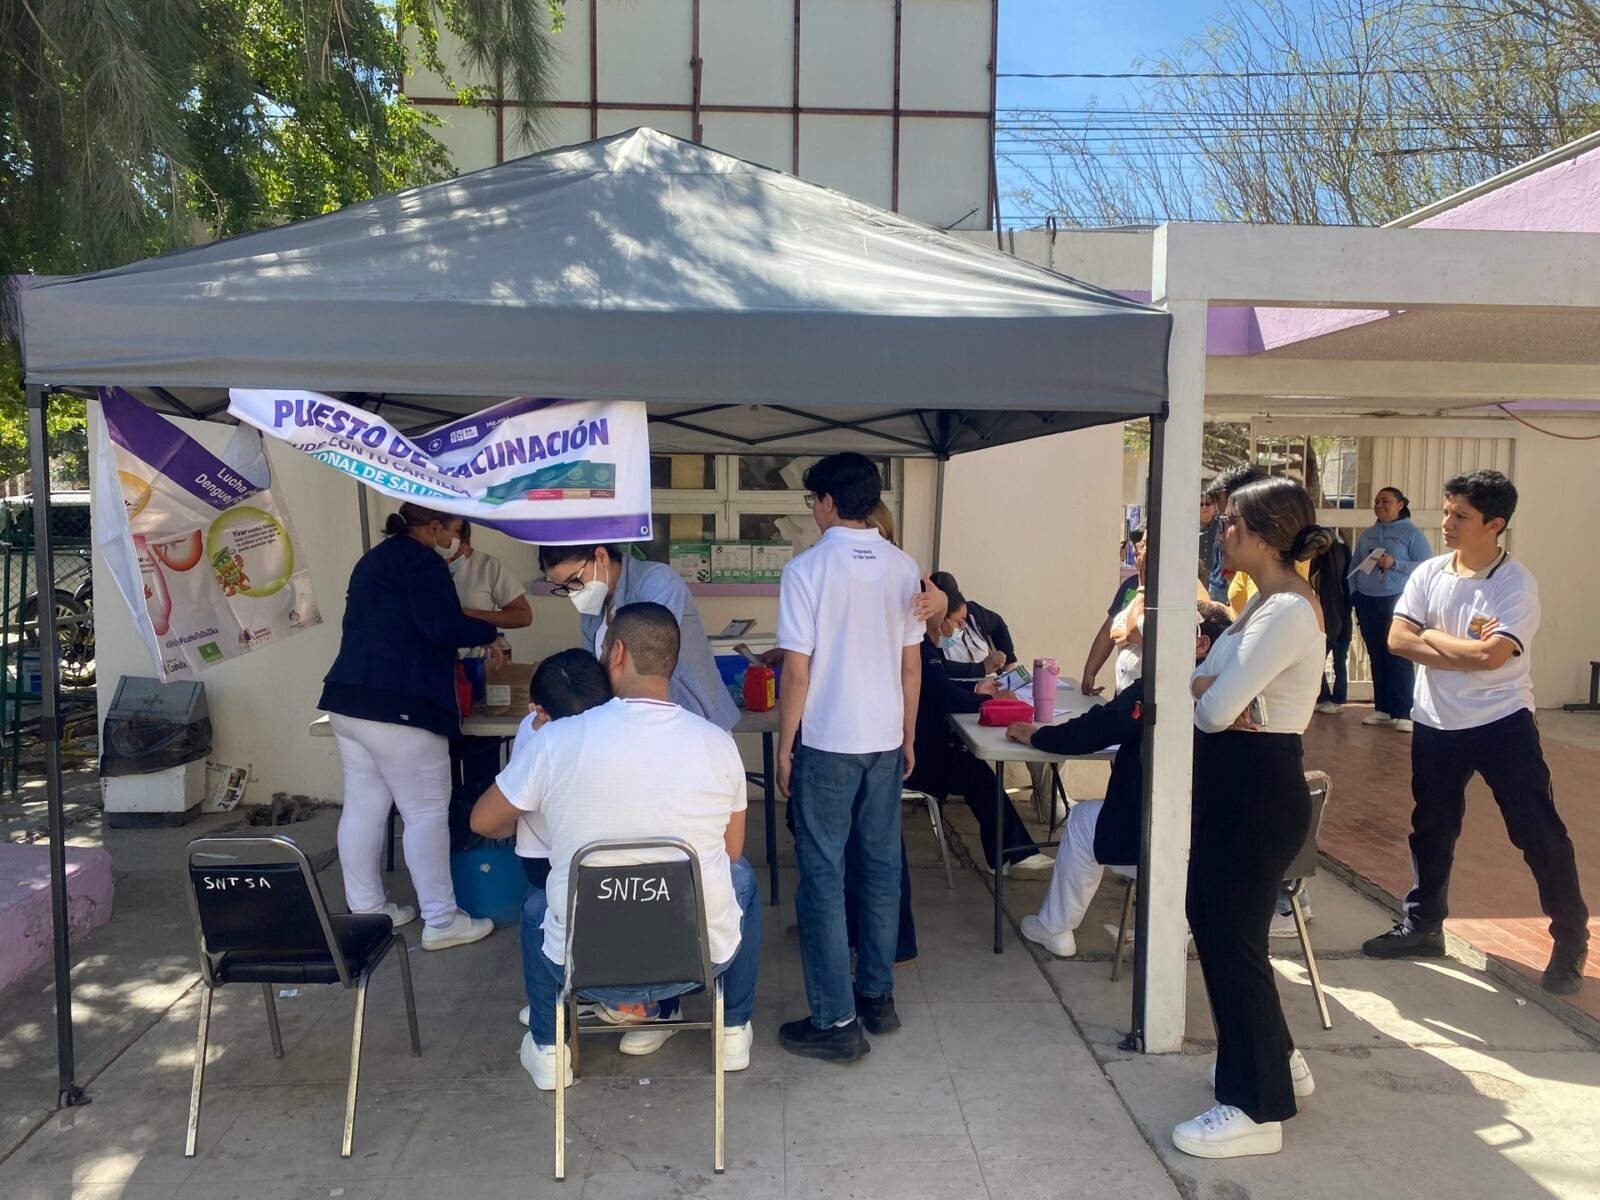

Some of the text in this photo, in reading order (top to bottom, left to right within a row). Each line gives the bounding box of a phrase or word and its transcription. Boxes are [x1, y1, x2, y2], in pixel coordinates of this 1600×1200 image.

[273, 399, 388, 448] PUESTO
[328, 436, 364, 455] CON
[368, 451, 388, 465] TU
[216, 467, 248, 493] Lucha
[313, 452, 359, 475] ONAL
[362, 464, 386, 485] DE
[232, 530, 248, 538] Tirar
[597, 877, 671, 902] SNTSA
